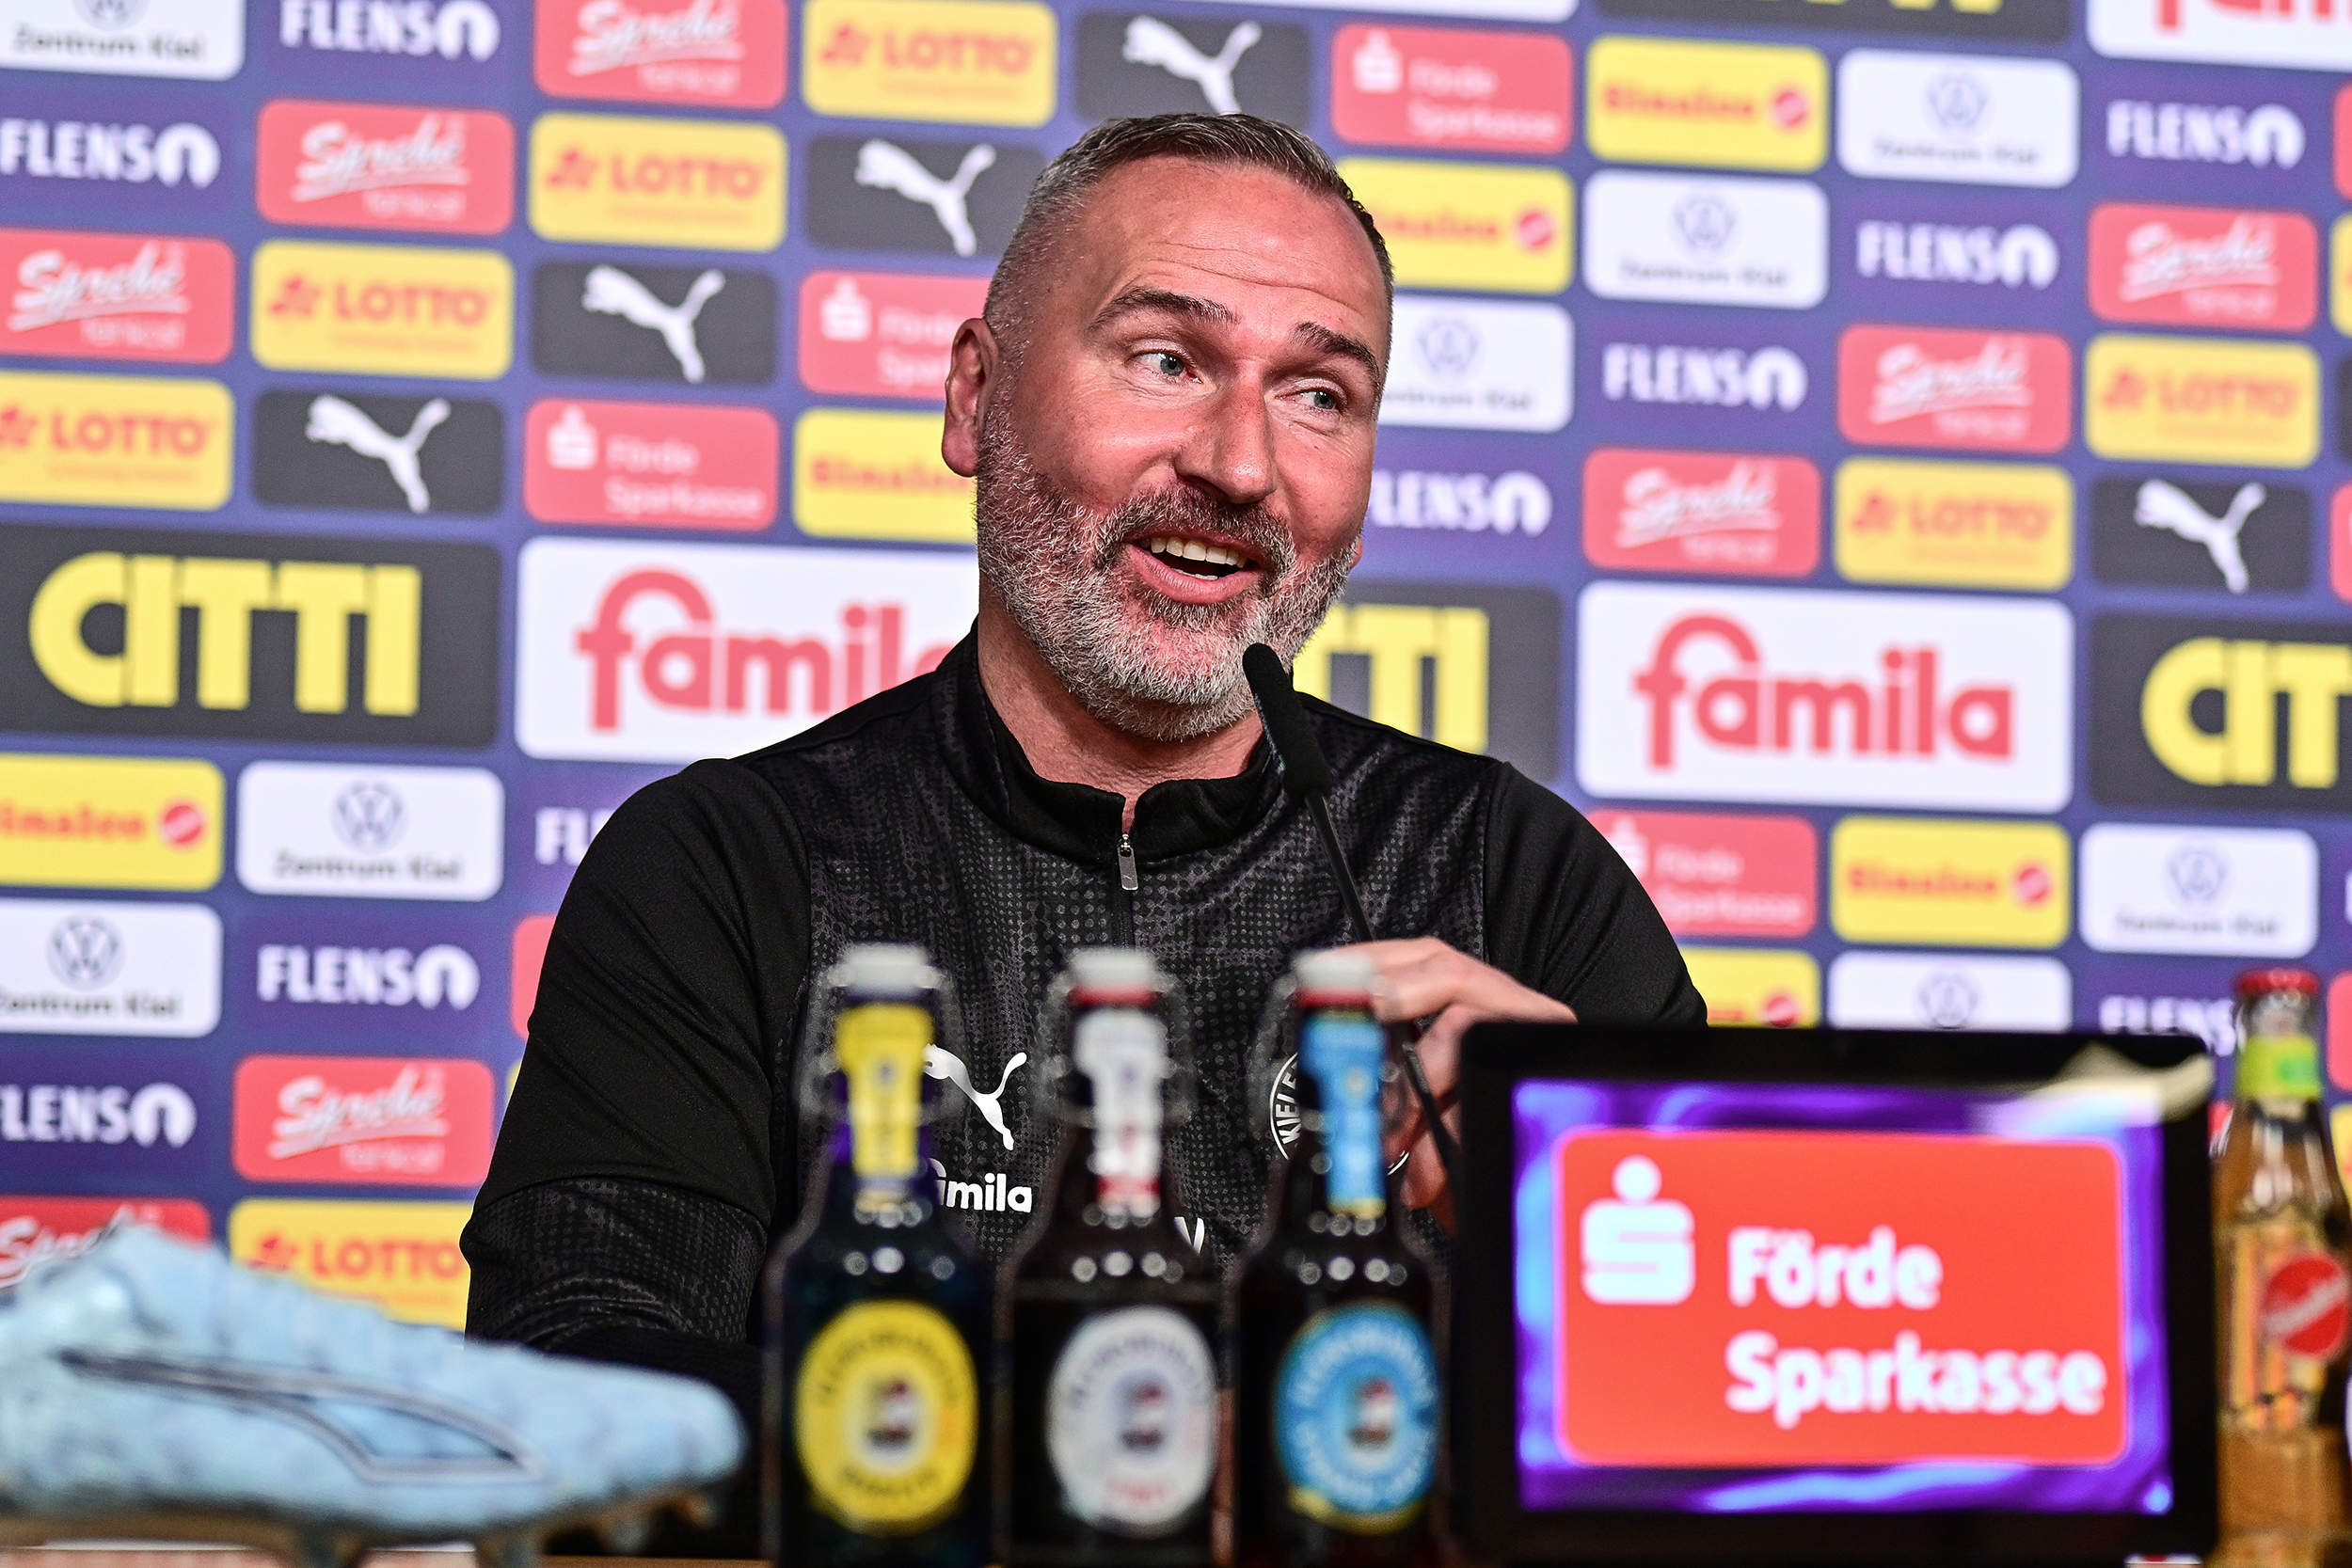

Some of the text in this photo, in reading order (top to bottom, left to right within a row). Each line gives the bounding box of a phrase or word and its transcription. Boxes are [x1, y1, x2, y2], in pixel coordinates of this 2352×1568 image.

[882, 34, 1035, 75] LOTTO
[610, 152, 765, 199] LOTTO
[333, 282, 490, 327] LOTTO
[50, 412, 208, 458] LOTTO
[28, 551, 423, 719] CITTI
[573, 564, 978, 736] famil
[1631, 610, 2015, 774] famila
[2140, 637, 2352, 789] CIT
[1725, 1224, 1944, 1310] Förde
[1724, 1329, 2109, 1429] Sparkasse
